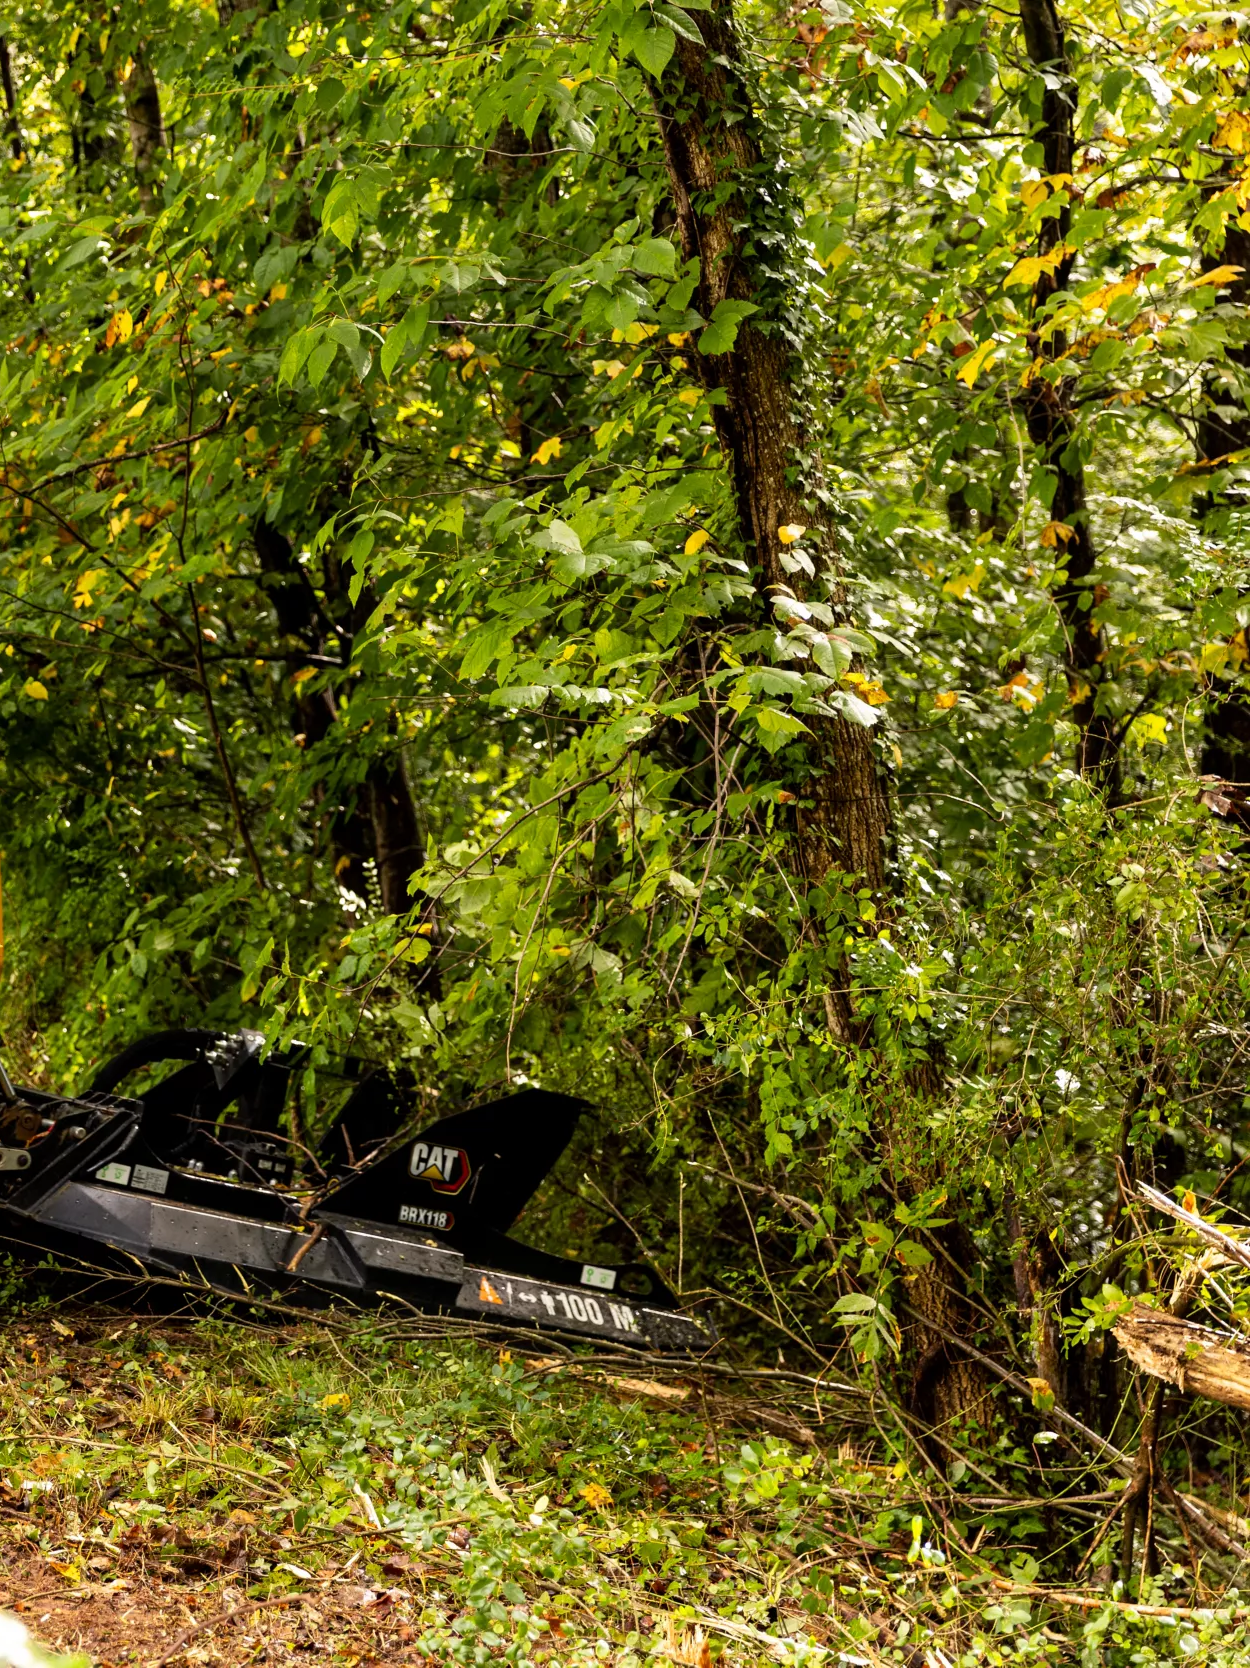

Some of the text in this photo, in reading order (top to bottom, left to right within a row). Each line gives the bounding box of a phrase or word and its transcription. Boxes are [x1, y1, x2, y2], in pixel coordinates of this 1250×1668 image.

[410, 1142, 459, 1182] CAT
[399, 1205, 448, 1228] BRX118
[555, 1292, 604, 1325] 100
